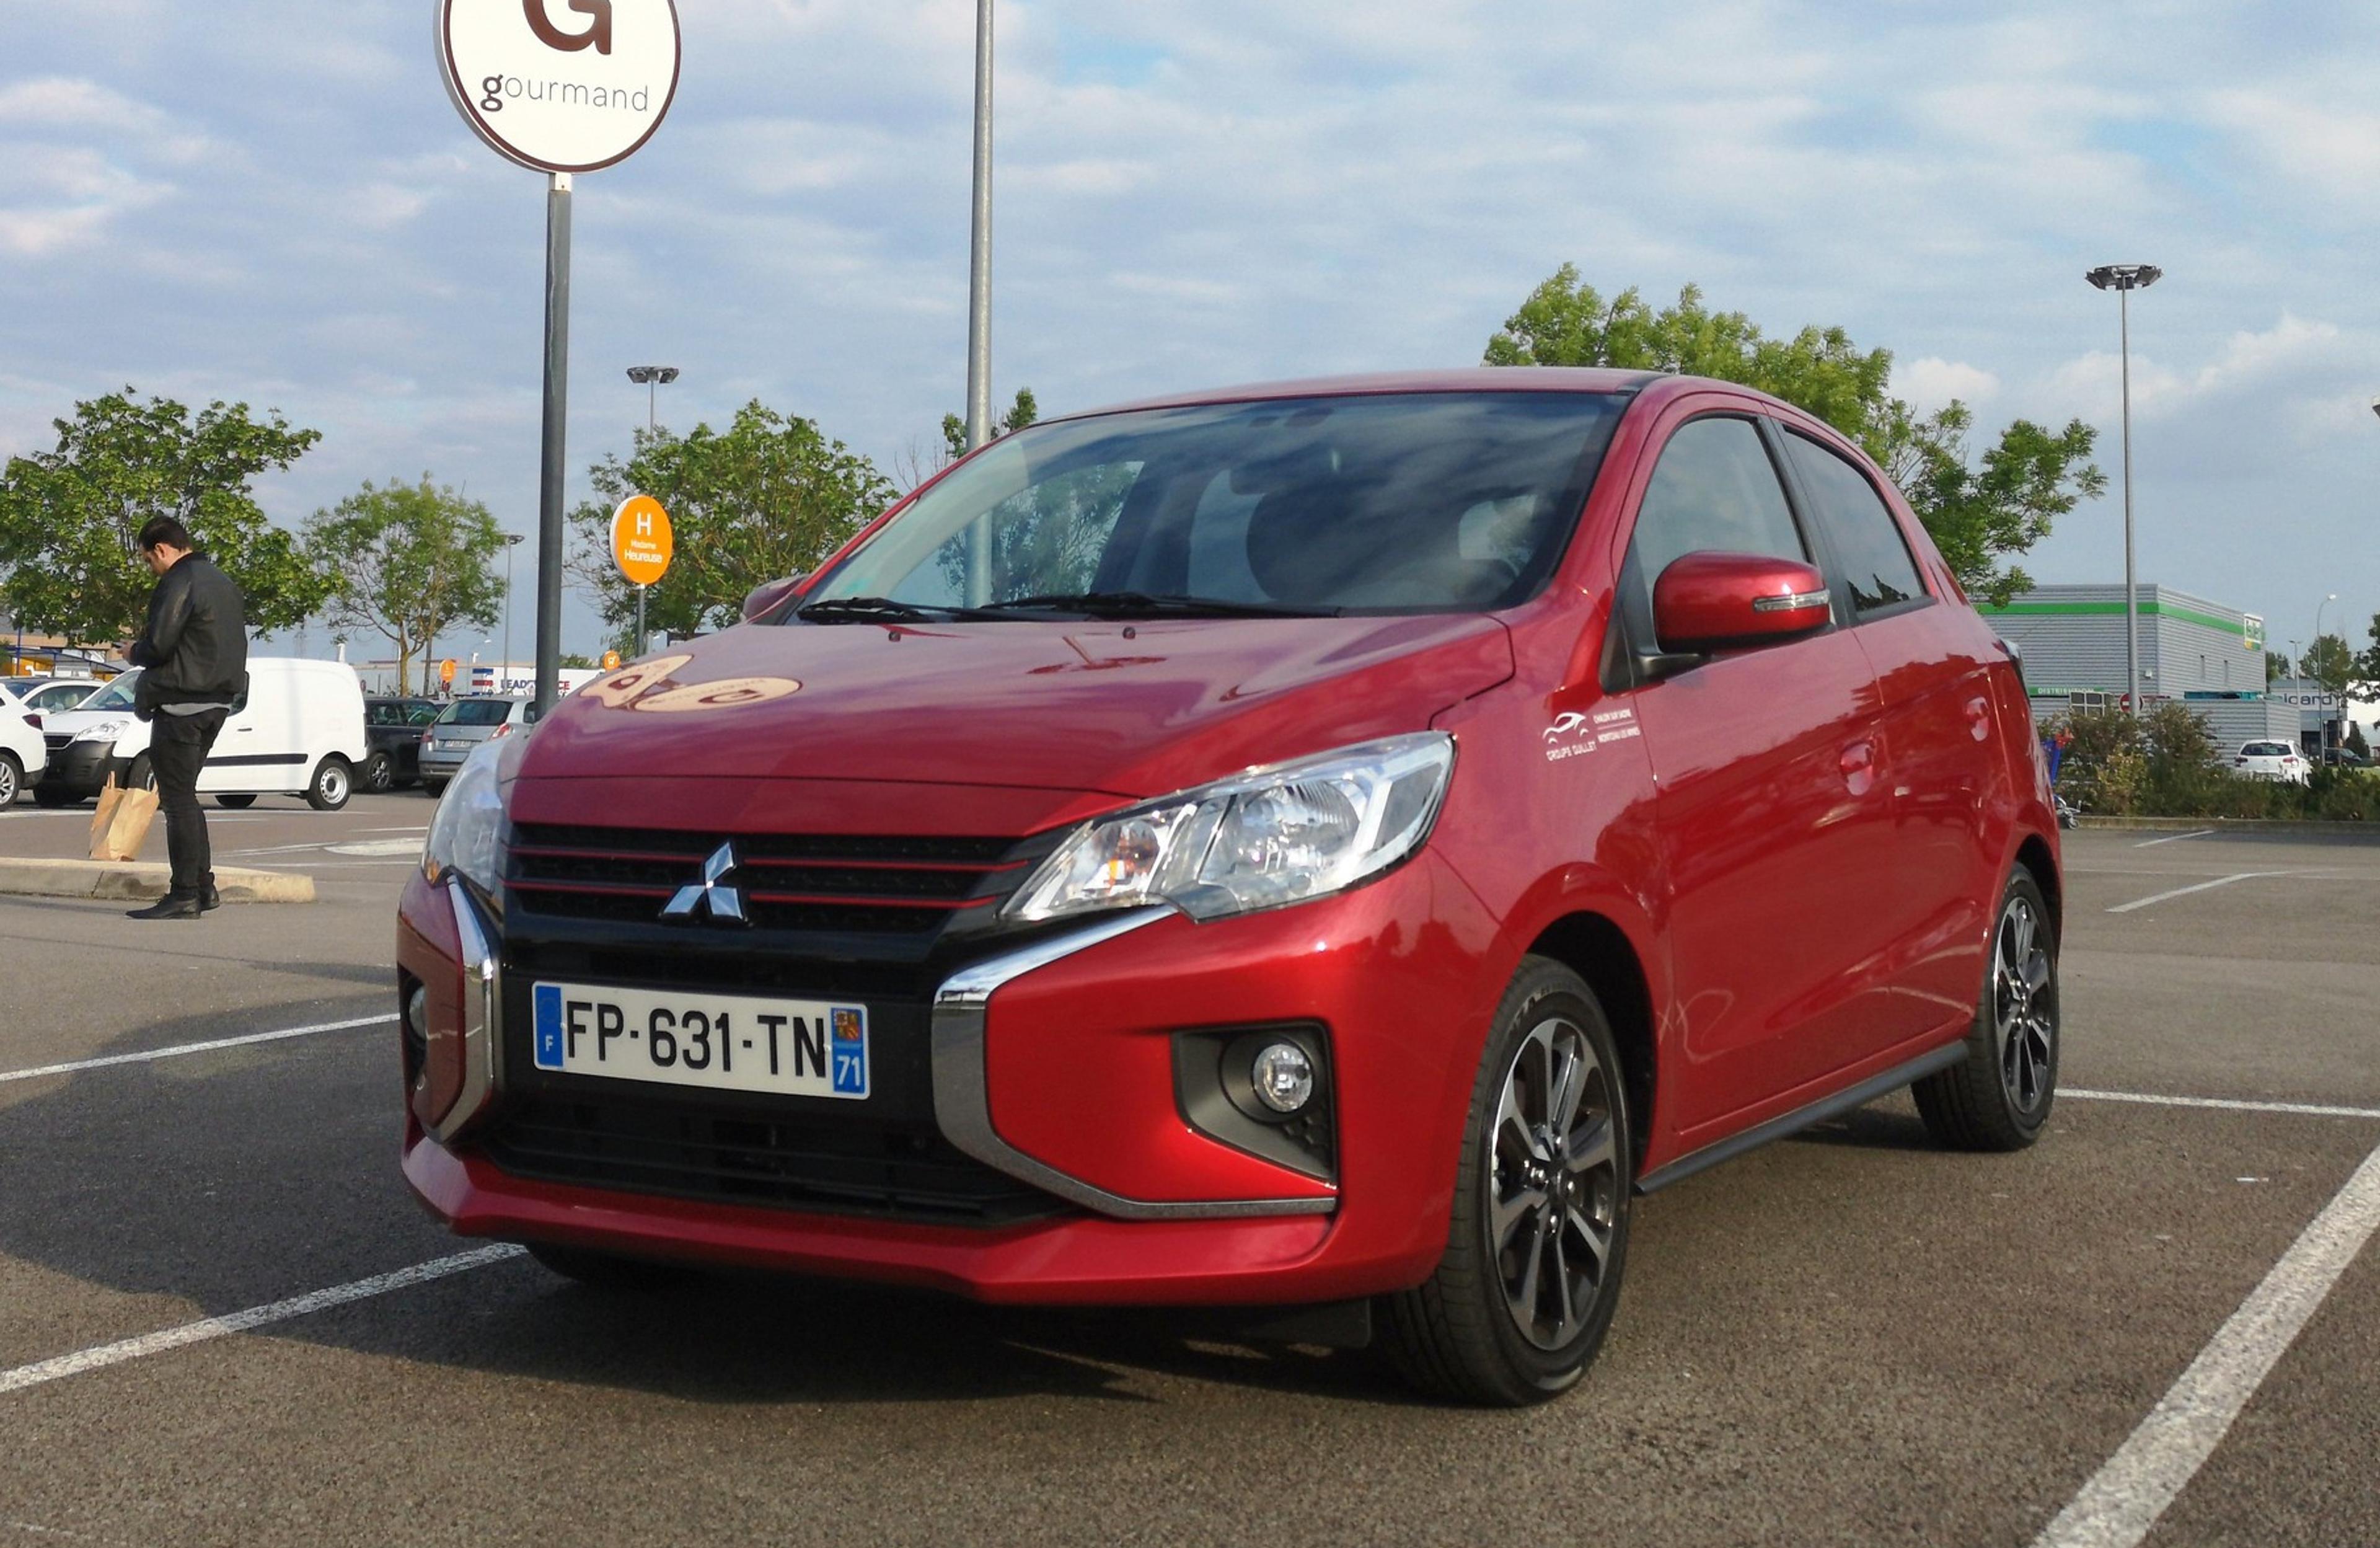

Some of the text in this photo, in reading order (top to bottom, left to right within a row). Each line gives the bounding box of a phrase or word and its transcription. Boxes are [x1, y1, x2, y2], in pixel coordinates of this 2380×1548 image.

[480, 74, 648, 112] gourmand
[636, 512, 651, 536] H
[624, 548, 663, 564] Heureuse
[2278, 693, 2332, 705] icard
[545, 1035, 553, 1051] F
[837, 1055, 860, 1087] 71
